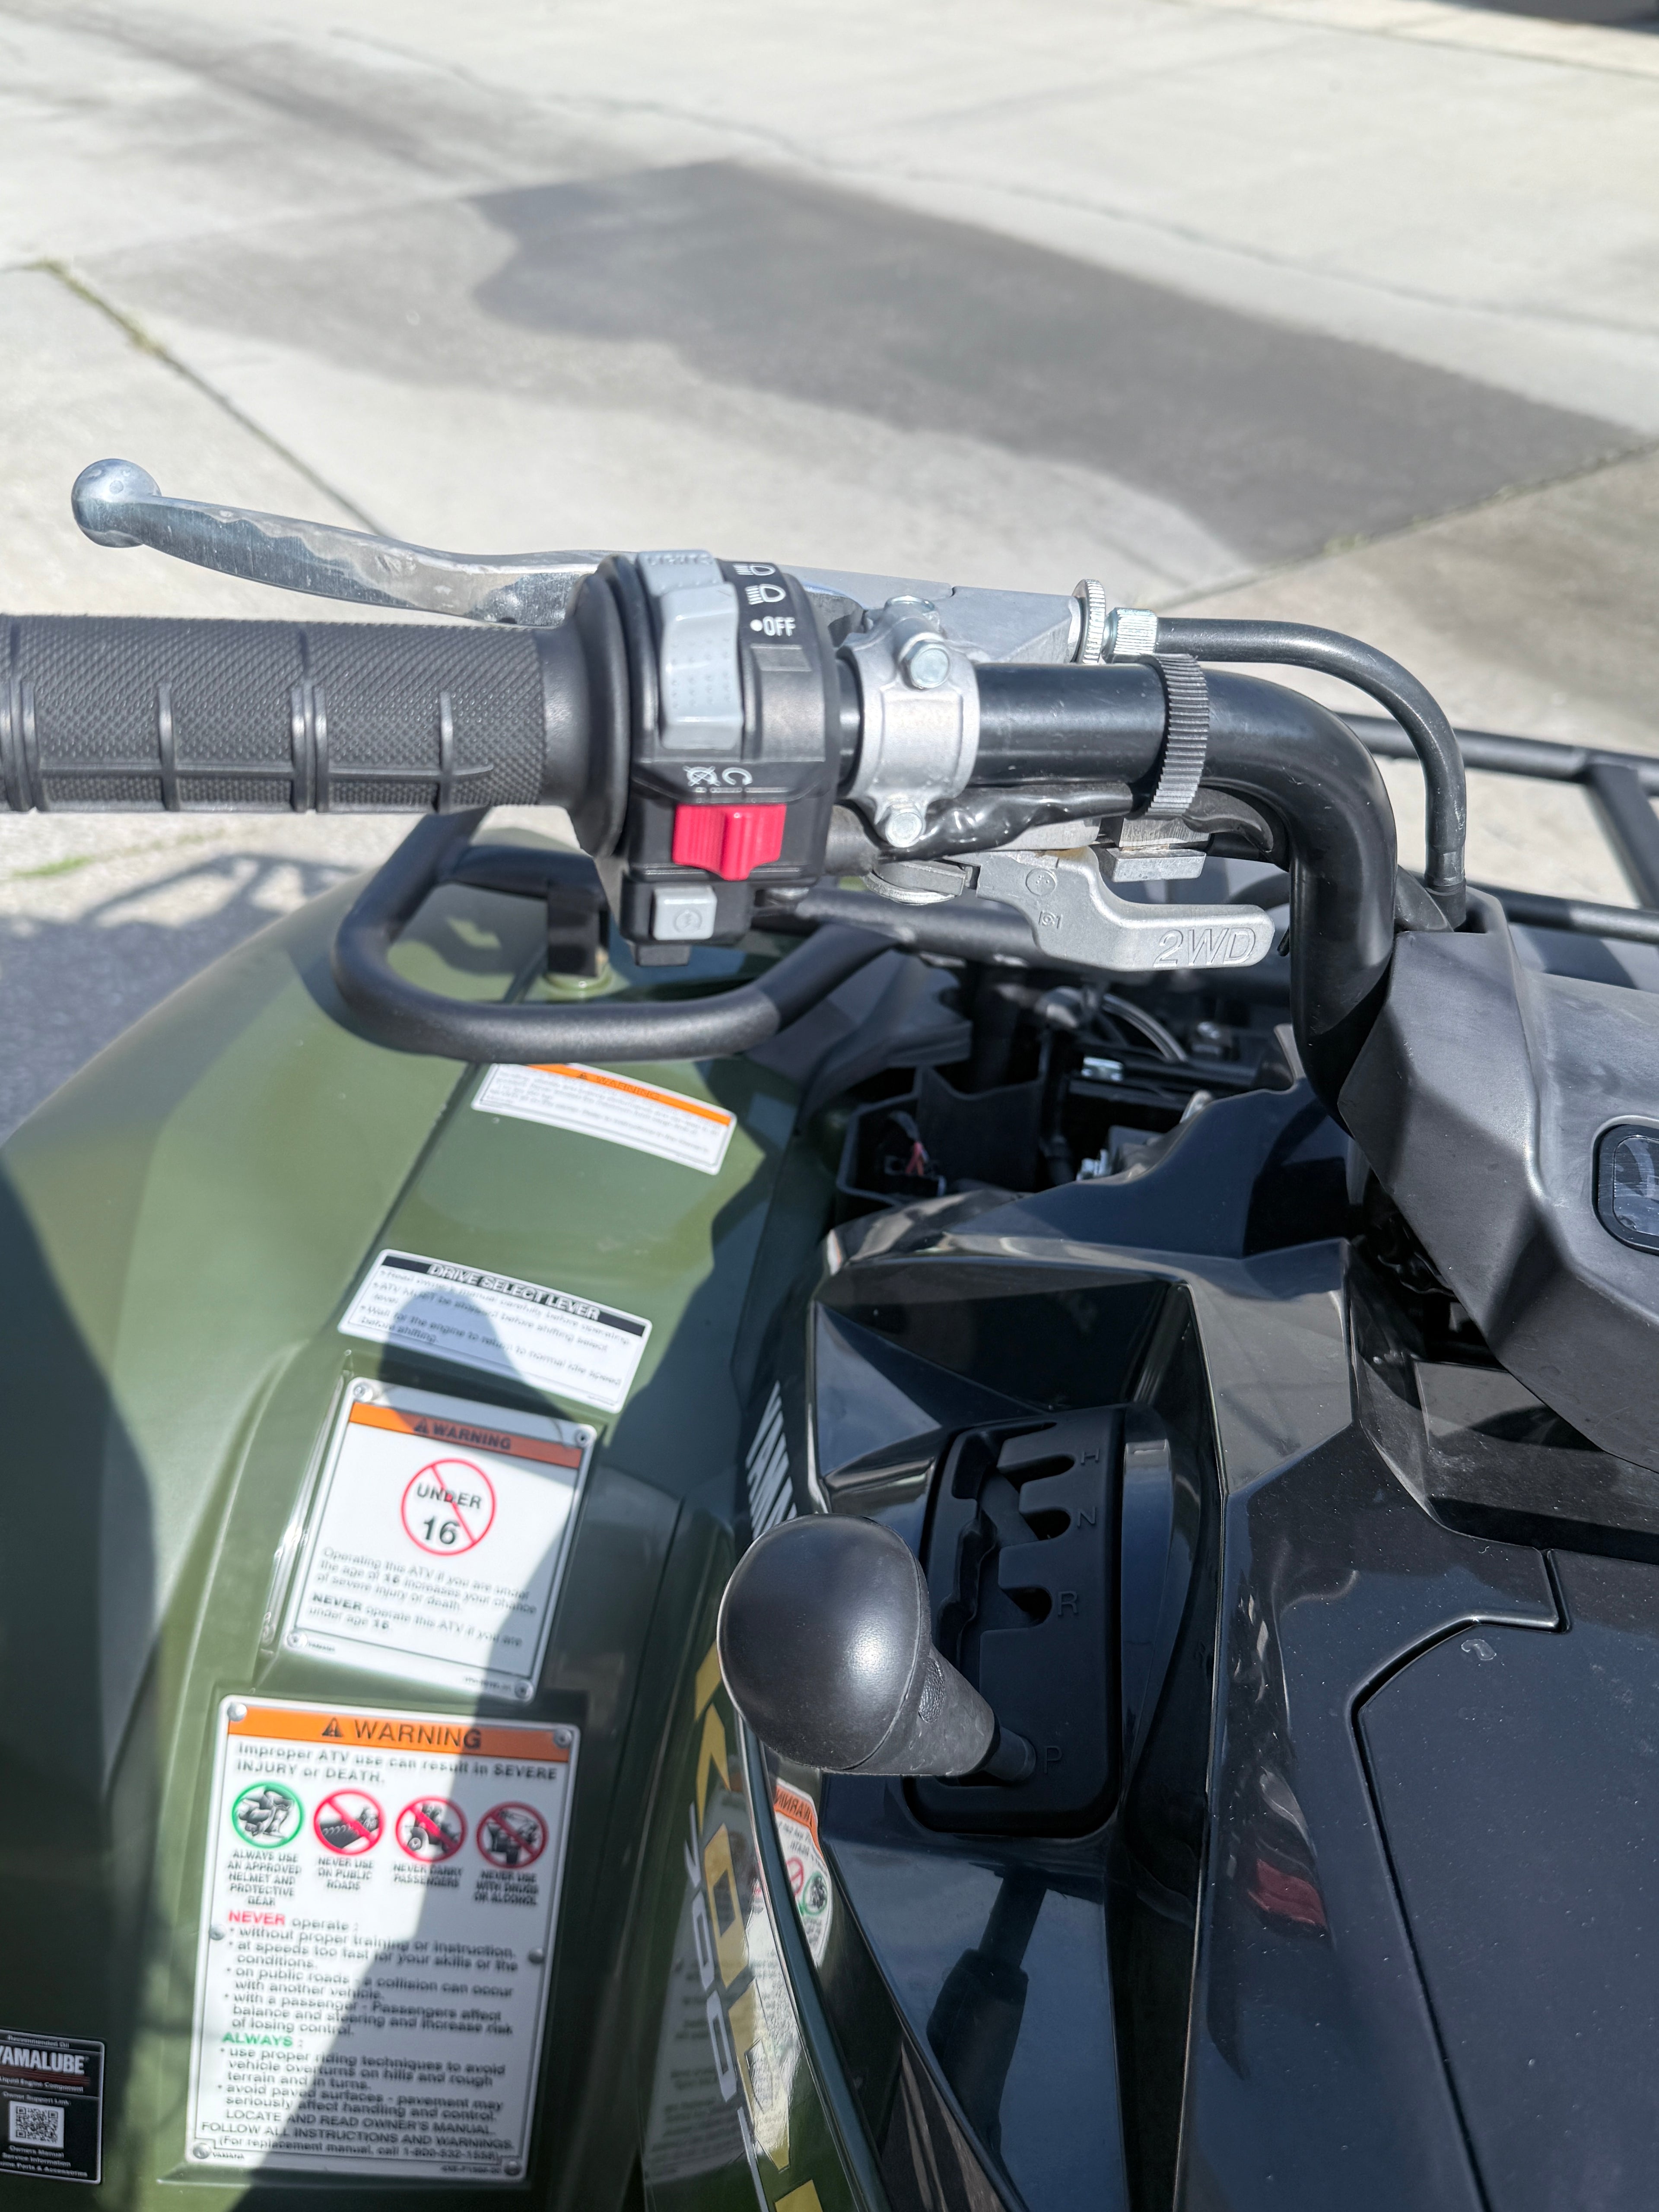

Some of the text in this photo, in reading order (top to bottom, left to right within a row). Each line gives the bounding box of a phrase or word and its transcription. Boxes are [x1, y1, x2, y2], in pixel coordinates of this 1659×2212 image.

[763, 616, 796, 636] OFF
[1153, 927, 1257, 968] 2WD
[428, 1263, 601, 1321] DRIVE SELECT LEVER
[432, 1423, 512, 1451] WARNING
[1080, 1448, 1100, 1465] H
[415, 1482, 483, 1510] UNDER
[1077, 1506, 1096, 1529] N
[420, 1514, 461, 1546] 16
[312, 1592, 362, 1611] NEVER
[1057, 1590, 1079, 1617] R
[353, 1719, 483, 1750] WARNING
[237, 1759, 298, 1776] INJURY
[304, 1768, 319, 1777] or
[238, 1742, 558, 1780] Improper ATV use can result in SEVERE
[1043, 1745, 1062, 1774] P
[228, 1860, 302, 1874] AN APPROVED
[232, 1849, 299, 1862] ALWAYS USE
[318, 1856, 374, 1868] NEVER USE
[229, 1872, 296, 1885] HELMET AND
[318, 1868, 372, 1879] ON PUBLIC
[230, 1883, 295, 1896] PROTECTIVE
[229, 1911, 350, 1932] NEVER operate
[239, 1925, 429, 1951] without proper training or
[238, 1941, 518, 1971] at speeds too fast for your skills or the
[235, 1967, 514, 1997] on public roads a collision can occur
[235, 1979, 264, 1990] with
[269, 1981, 324, 1995] another
[234, 1991, 264, 2003] with
[281, 1997, 356, 2012] passenger
[372, 2000, 458, 2019] Passengers
[461, 2007, 502, 2021] affect
[232, 2018, 245, 2028] of
[250, 2018, 295, 2033] losing
[233, 2004, 514, 2034] balance and steering and increase risk
[222, 2031, 293, 2047] ALWAYS
[229, 2047, 505, 2074] use proper riding techniques to avoid
[227, 2071, 275, 2083] terrain
[280, 2074, 308, 2085] and
[313, 2076, 325, 2086] in
[228, 2059, 493, 2088] vehicle overturns on hills and rough
[226, 2083, 503, 2113] avoid paved surfaces pavement may
[226, 2094, 438, 2117] seriously affect handling and
[226, 2109, 281, 2122] LOCATE
[287, 2113, 316, 2124] AND
[320, 2115, 359, 2126] READ
[361, 2117, 429, 2131] OWNER'S
[202, 2122, 261, 2135] FOLLOW
[264, 2126, 290, 2136] ALL
[295, 2127, 398, 2143] INSTRUCTIONS
[401, 2134, 432, 2145] AND
[248, 2136, 322, 2152] replacement
[376, 2144, 399, 2155] call
